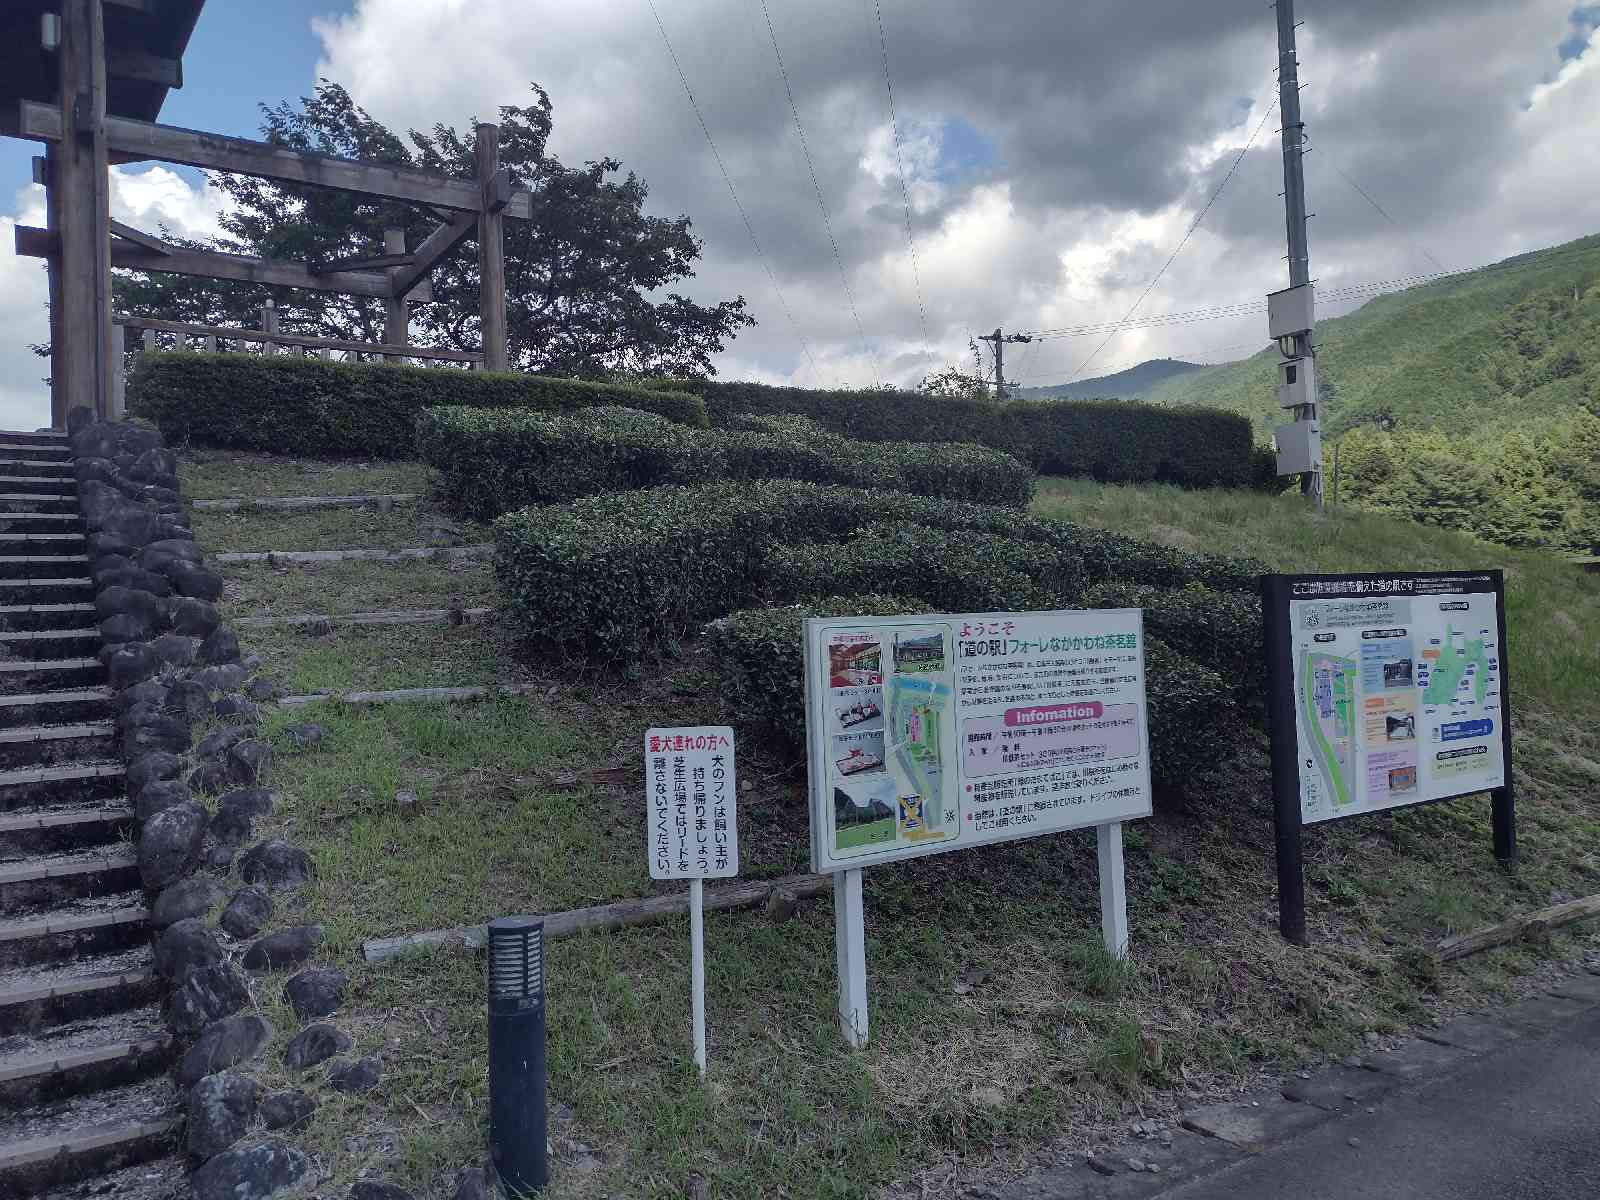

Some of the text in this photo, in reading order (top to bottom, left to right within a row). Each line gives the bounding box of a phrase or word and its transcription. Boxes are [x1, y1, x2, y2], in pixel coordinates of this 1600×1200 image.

[959, 621, 1016, 637] ようこそ
[649, 735, 729, 752] 愛犬連れの方へ
[1016, 706, 1094, 723] Infomation
[673, 756, 689, 872] 芝生広場ではリードを
[693, 767, 708, 874] 持ち帰りましょう。
[711, 755, 728, 871] 犬のフンは飼い主が
